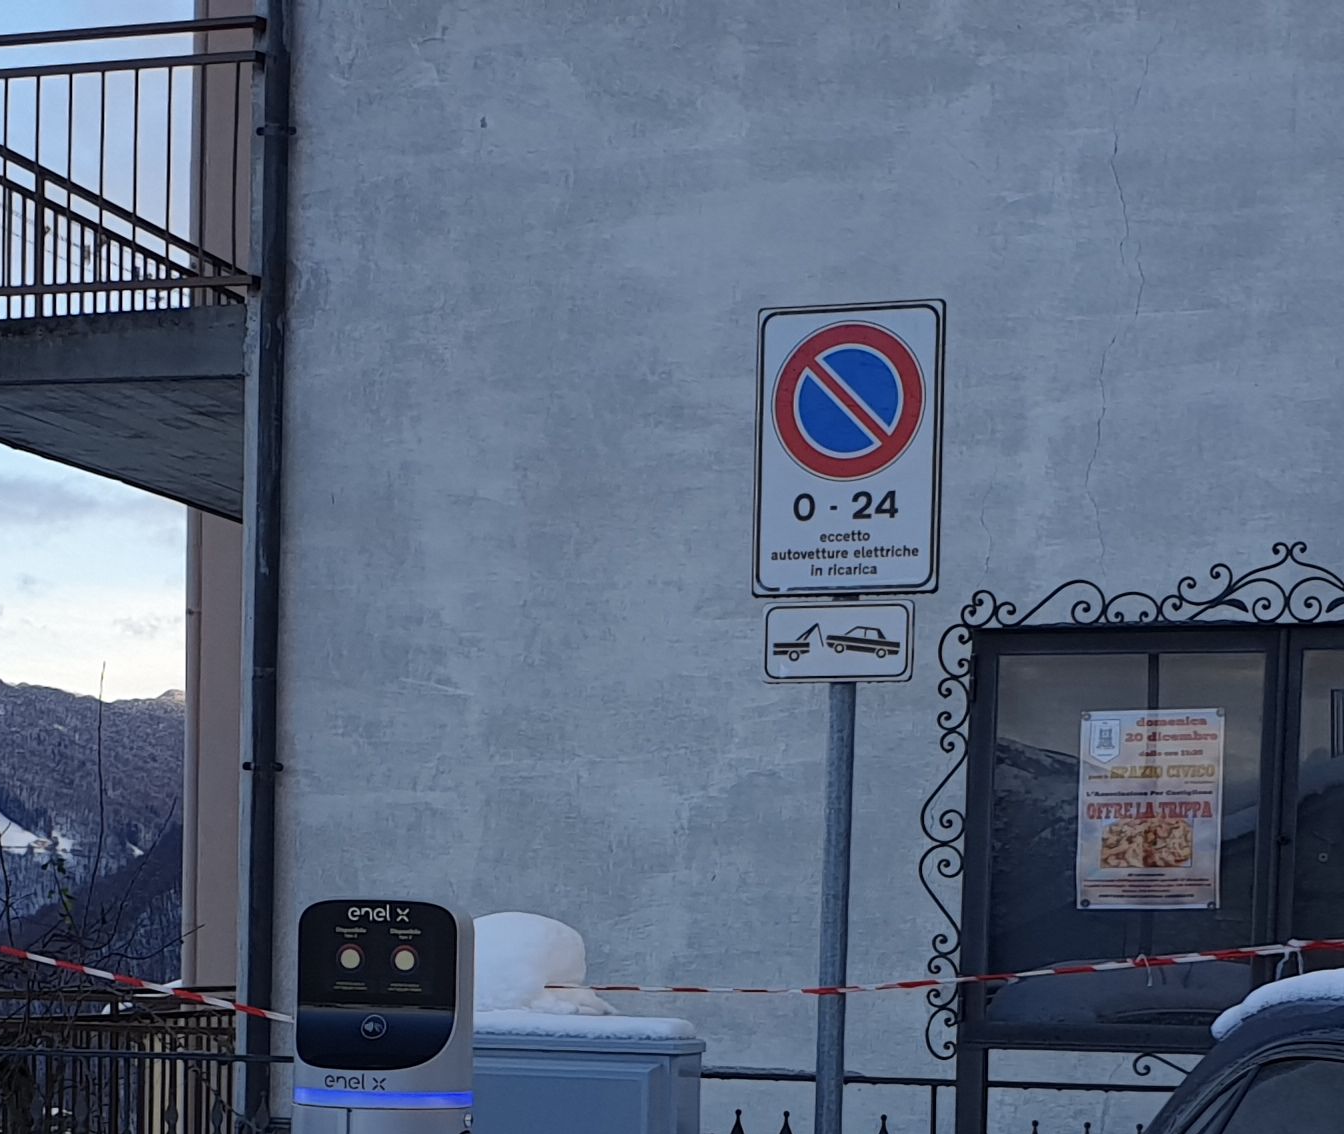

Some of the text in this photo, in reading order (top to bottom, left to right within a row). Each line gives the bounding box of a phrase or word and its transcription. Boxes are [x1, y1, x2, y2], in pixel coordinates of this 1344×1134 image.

[793, 493, 816, 522] 0
[851, 490, 899, 520] 24
[819, 530, 871, 543] eccetto
[771, 545, 919, 561] autovetture elettriche
[810, 563, 878, 577] in ricarica
[1136, 717, 1208, 727] domenica
[1125, 731, 1218, 742] 20 dicembre
[1110, 764, 1216, 779] SPAZIO CIVICO
[1087, 801, 1213, 819] OFFRE LA TRIPPA
[348, 904, 390, 921] enel
[324, 1073, 365, 1090] enel
